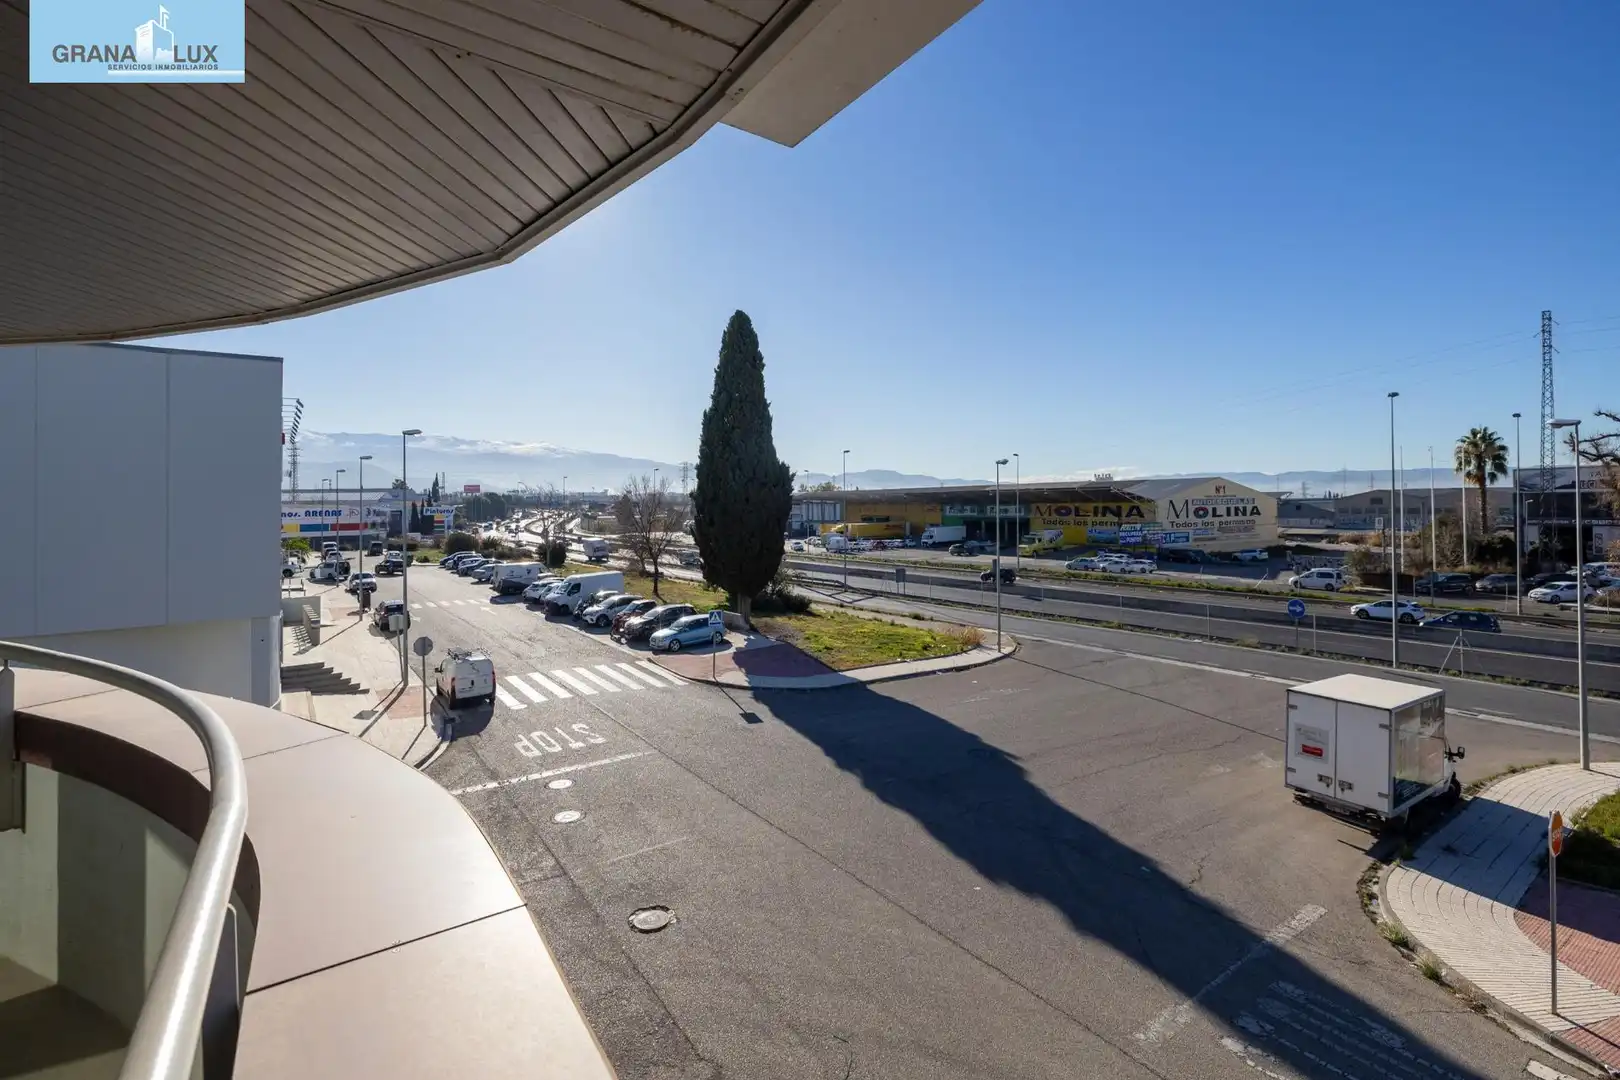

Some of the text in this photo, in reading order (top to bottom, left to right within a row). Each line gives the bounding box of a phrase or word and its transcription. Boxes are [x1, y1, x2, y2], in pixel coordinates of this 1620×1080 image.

[304, 509, 342, 517] ARENAS
[1034, 505, 1145, 518] MOLINA
[1166, 499, 1262, 520] MOLINA
[1042, 518, 1070, 526] Todos
[1169, 519, 1256, 529] Todos los permisos
[513, 723, 607, 758] STOP
